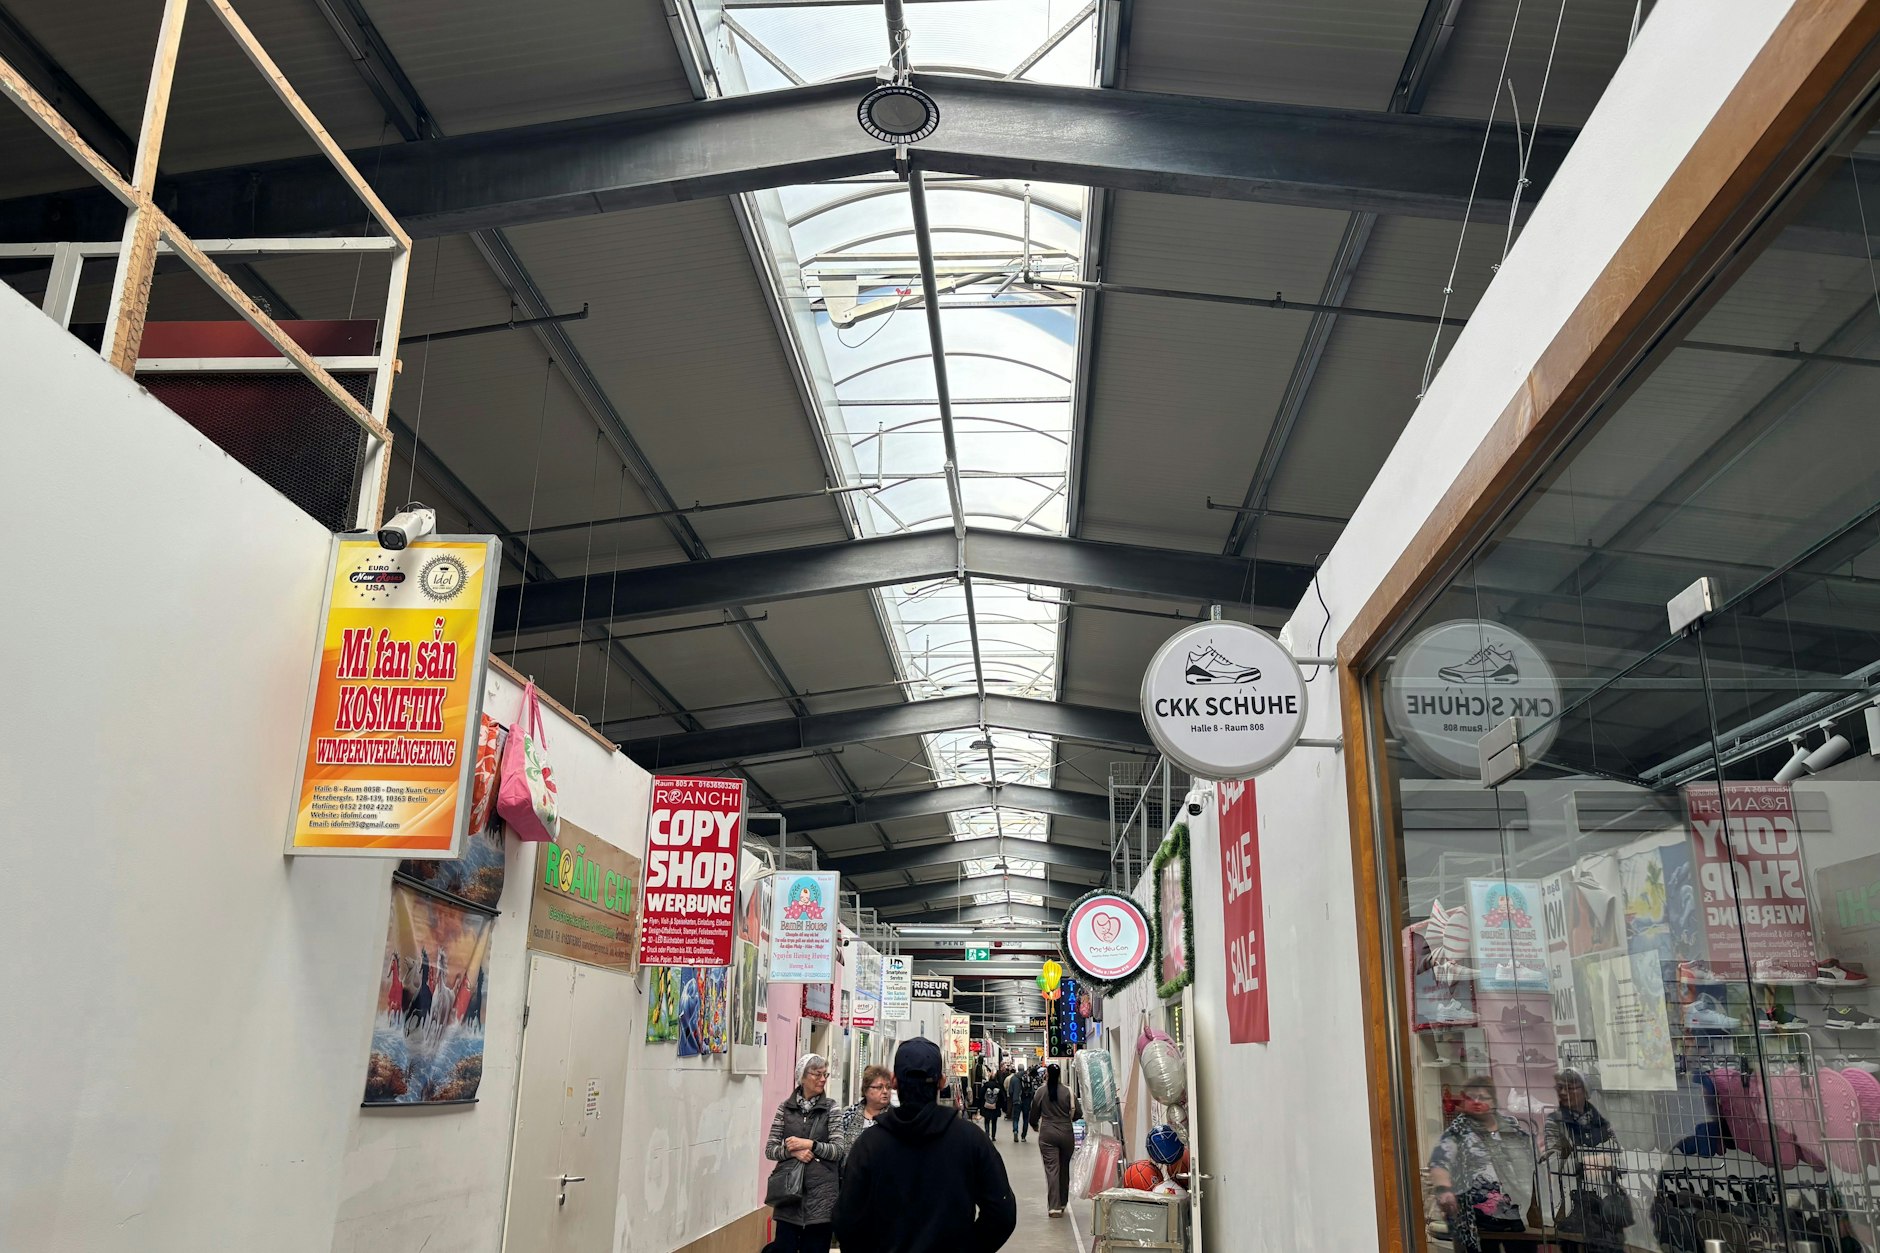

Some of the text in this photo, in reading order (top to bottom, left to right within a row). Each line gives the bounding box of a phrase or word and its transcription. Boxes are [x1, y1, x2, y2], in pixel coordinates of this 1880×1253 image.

[352, 573, 374, 582] New
[337, 627, 373, 679] Mi
[371, 628, 411, 679] fan
[335, 685, 447, 731] KOSMETIK
[1155, 695, 1298, 718] CKK SCHUHE
[1190, 724, 1212, 733] Halle
[1224, 724, 1248, 732] Raum
[316, 737, 456, 766] WIMPERNVERLÄNGERUNG
[650, 809, 740, 848] COPY
[646, 850, 735, 891] SHOP &
[1225, 831, 1253, 904] SALE
[604, 870, 632, 916] CHI
[646, 893, 732, 917] WERBUNG
[1230, 930, 1259, 997] SALE
[914, 989, 942, 997] NAILS
[1068, 981, 1078, 1043] TATTOO
